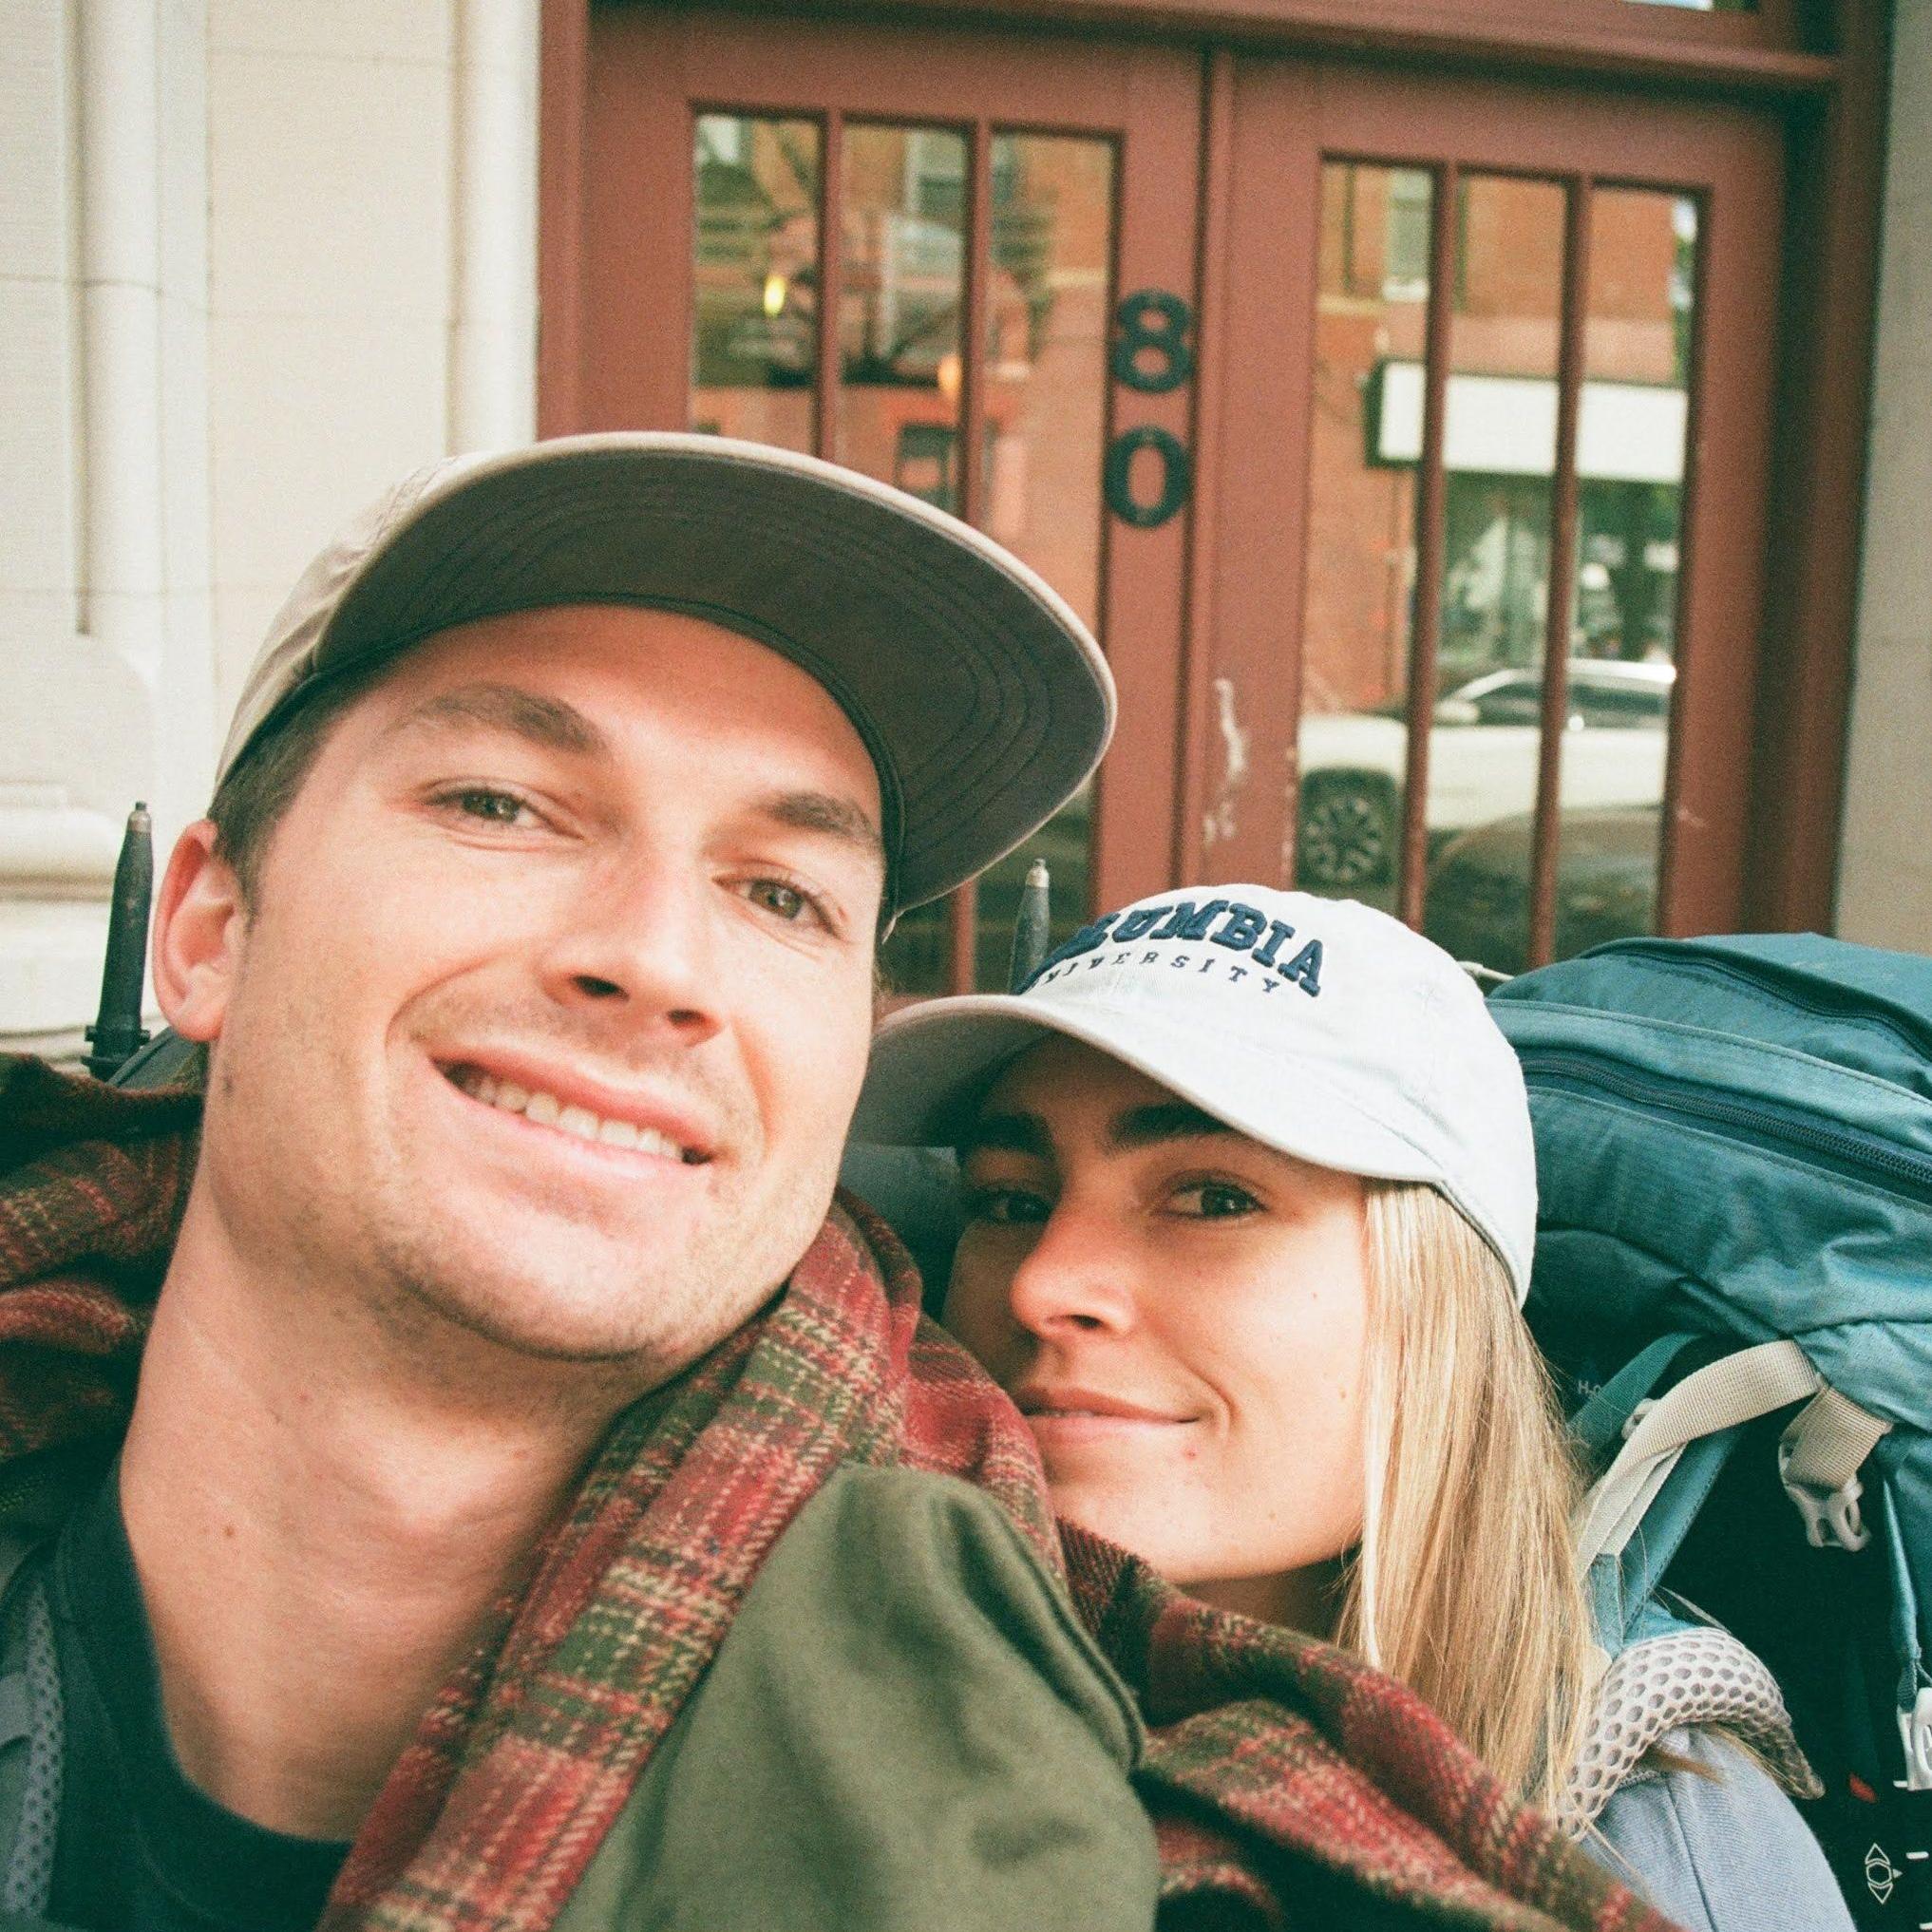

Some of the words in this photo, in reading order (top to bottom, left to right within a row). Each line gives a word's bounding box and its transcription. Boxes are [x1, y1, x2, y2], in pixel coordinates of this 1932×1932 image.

[1105, 290, 1194, 528] 80
[1013, 899, 1324, 997] LUMBIA
[1026, 951, 1279, 994] NIVERSITY
